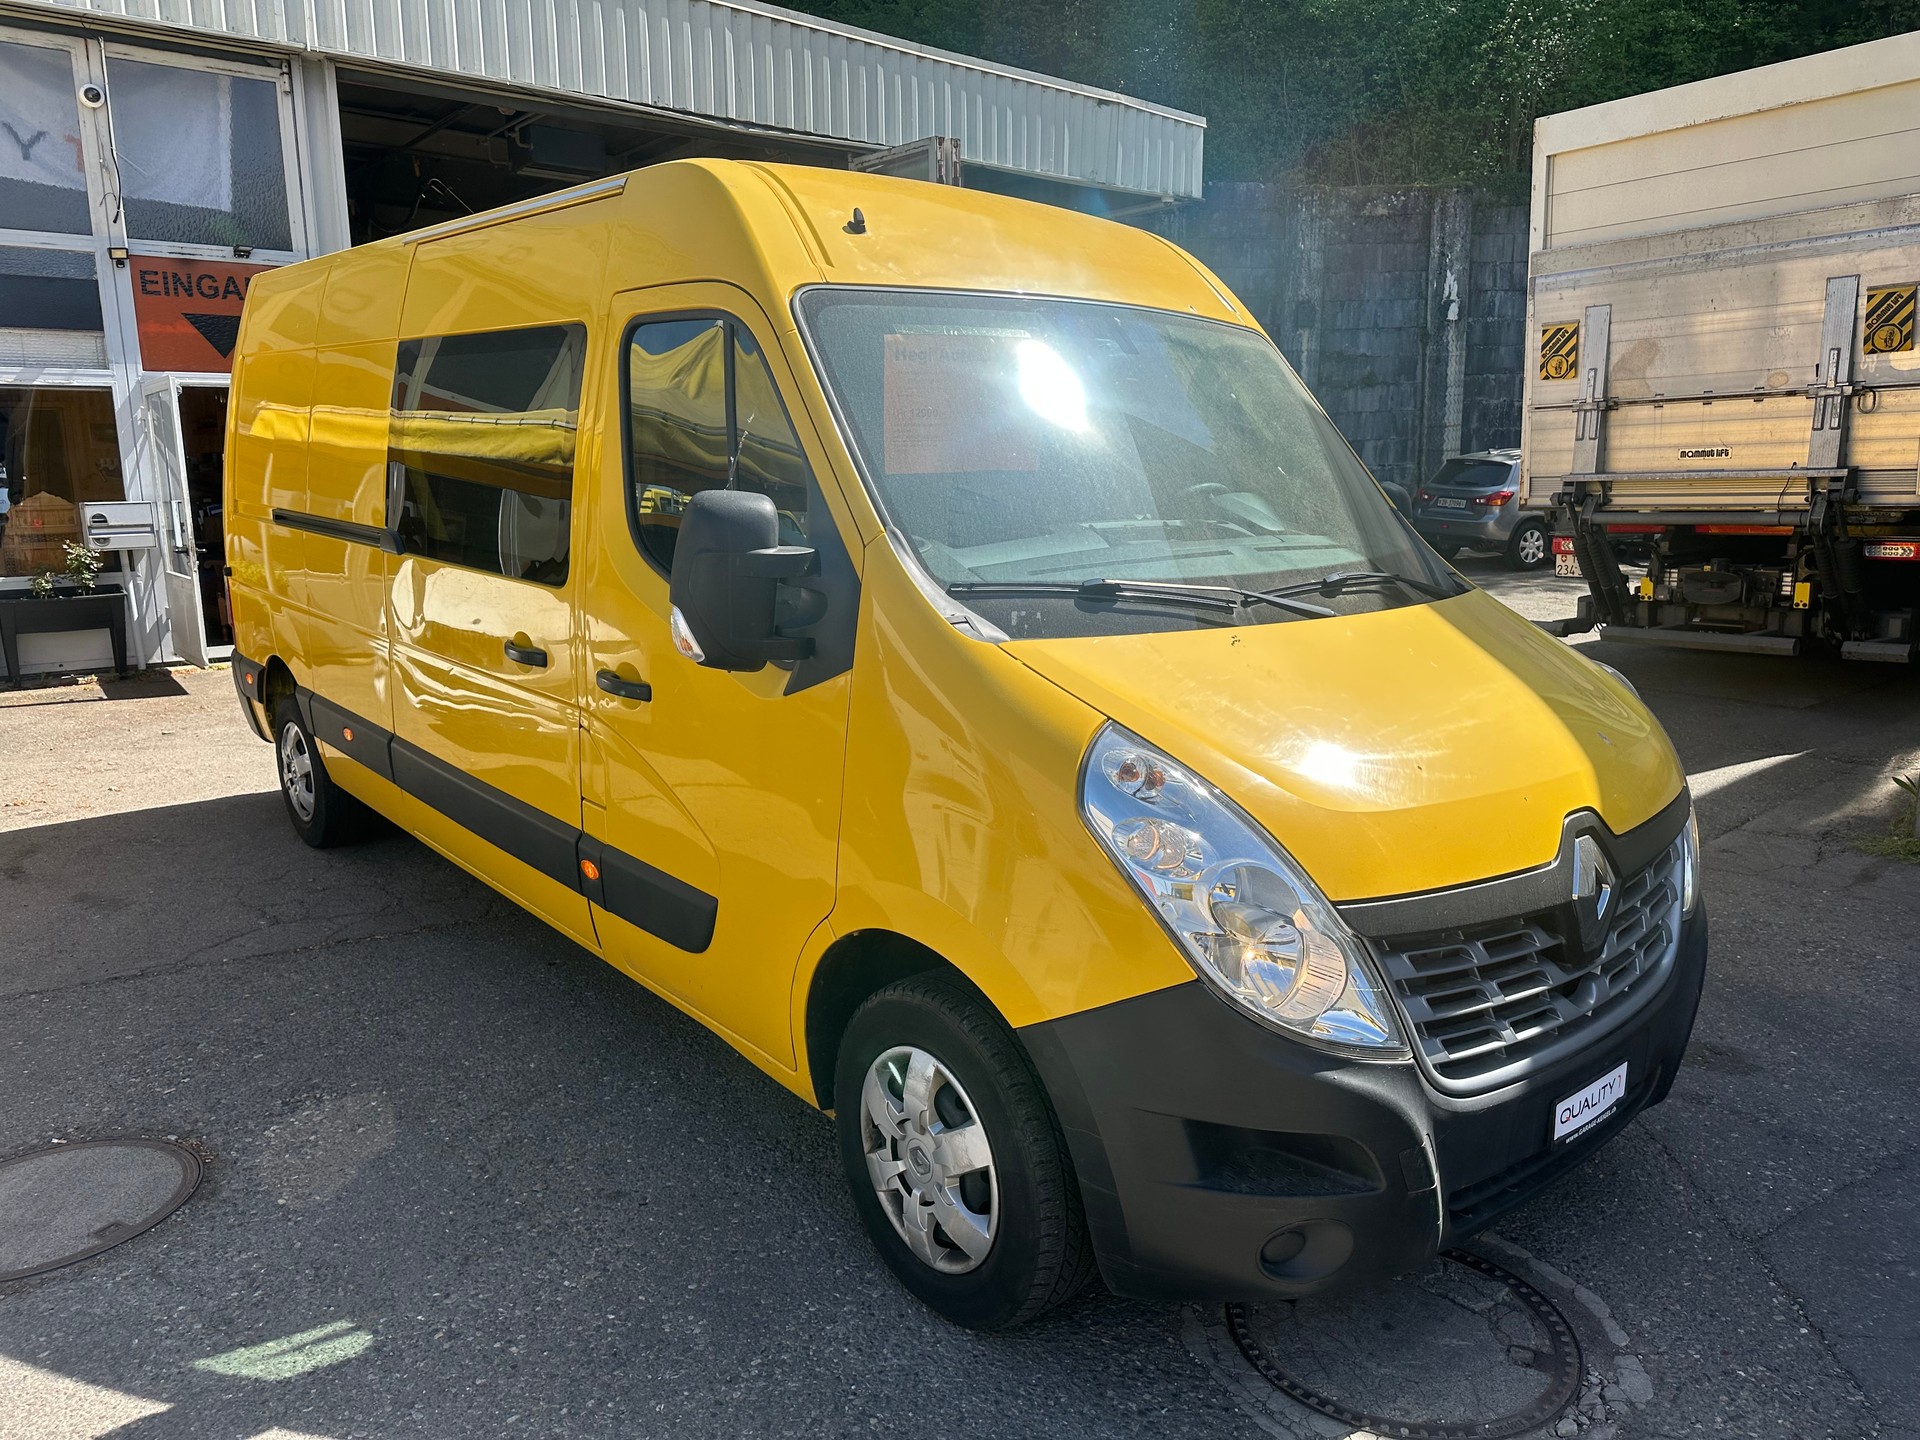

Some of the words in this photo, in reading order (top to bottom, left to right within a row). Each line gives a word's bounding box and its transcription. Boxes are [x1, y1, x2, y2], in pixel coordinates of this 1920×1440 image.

[1680, 449, 1715, 458] mammut
[1716, 448, 1729, 457] lift
[1560, 1078, 1616, 1125] QUALITY
